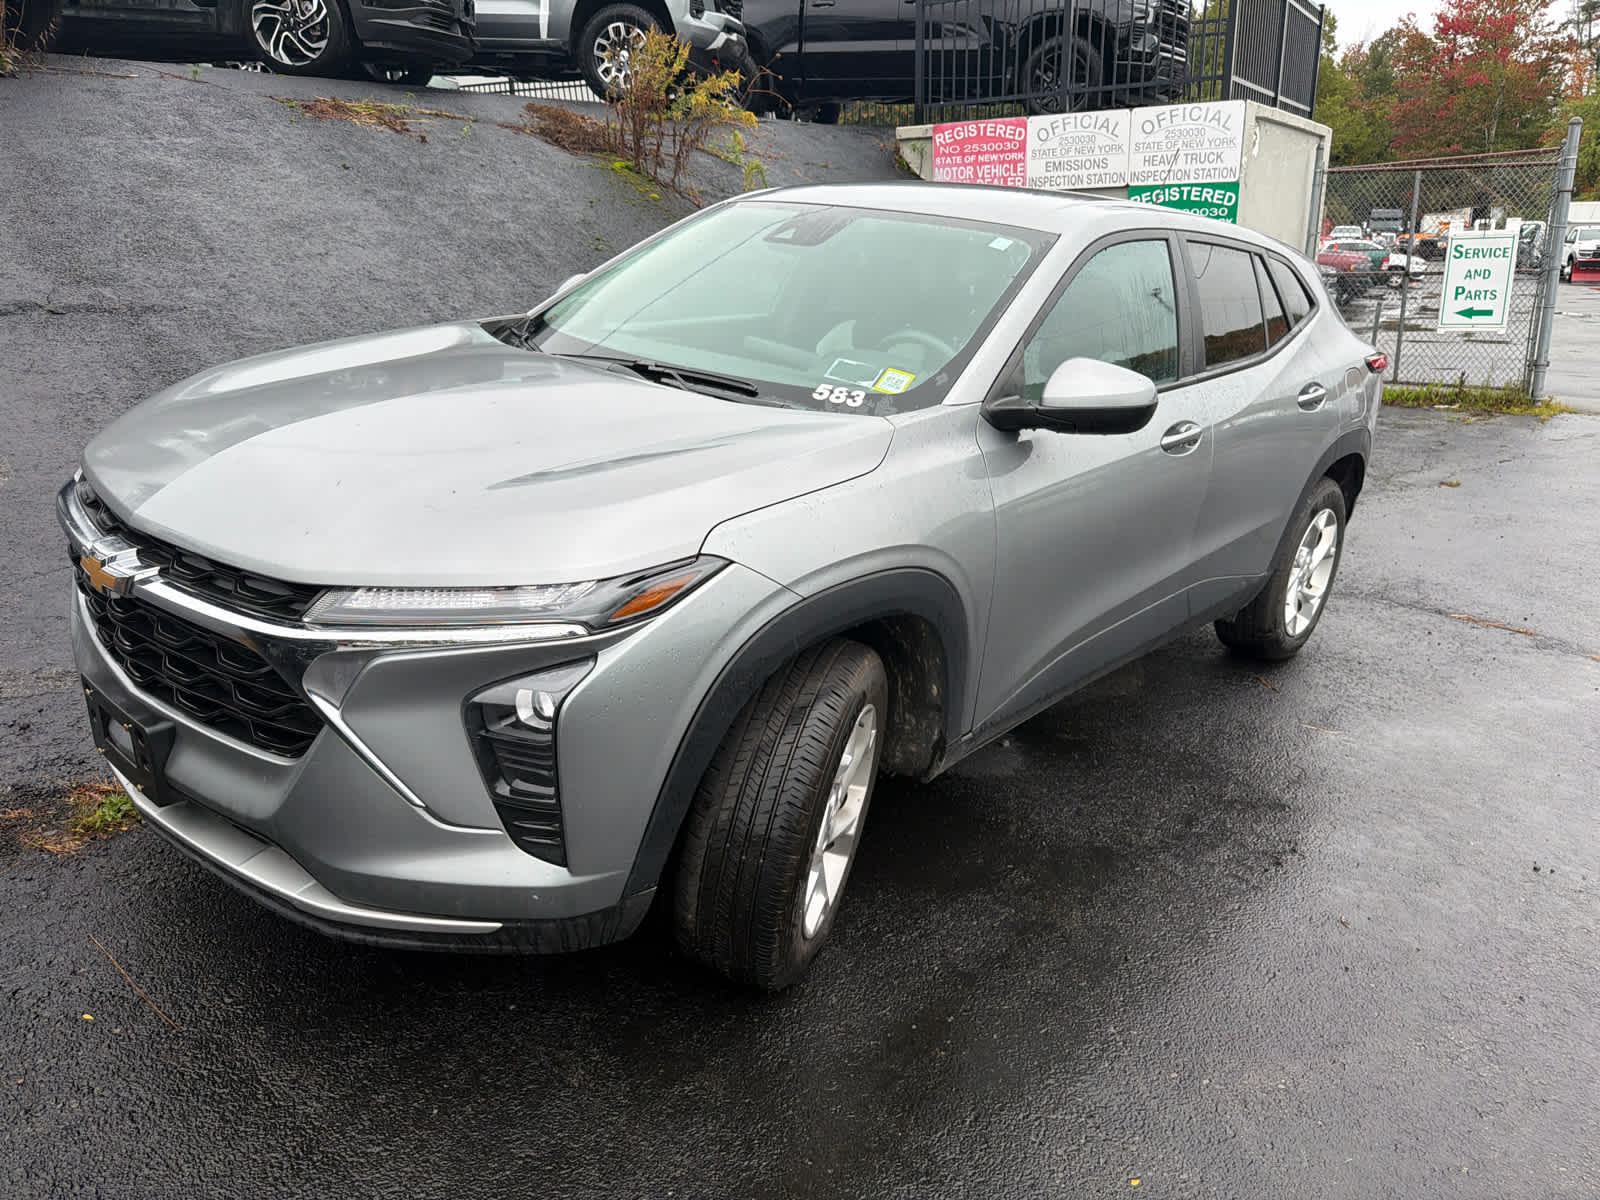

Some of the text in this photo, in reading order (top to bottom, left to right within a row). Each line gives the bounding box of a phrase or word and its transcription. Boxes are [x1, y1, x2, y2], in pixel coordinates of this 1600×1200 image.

[1141, 105, 1231, 134] OFFICIAL
[935, 123, 1026, 146] REGISTERED
[1037, 114, 1120, 142] OFFICIAL
[1164, 127, 1206, 138] 2530030
[940, 141, 1020, 154] NO 2530030
[1059, 134, 1097, 146] 2530030
[1134, 137, 1237, 152] STATE OF NEW YORK
[1031, 143, 1124, 158] STATE OF NEW YORK
[1184, 151, 1224, 164] TRUCK
[935, 152, 1025, 165] STATE OF NEW YORK
[1045, 157, 1109, 173] EMISSIONS
[935, 163, 1025, 180] MOTOR VEHICLE
[1130, 167, 1237, 183] INSPECTION STATION
[1028, 171, 1126, 188] INSPECTION STATION
[1453, 244, 1510, 259] SERVICE
[1464, 268, 1491, 280] AND
[1454, 286, 1497, 301] PARTS
[812, 384, 866, 408] 583
